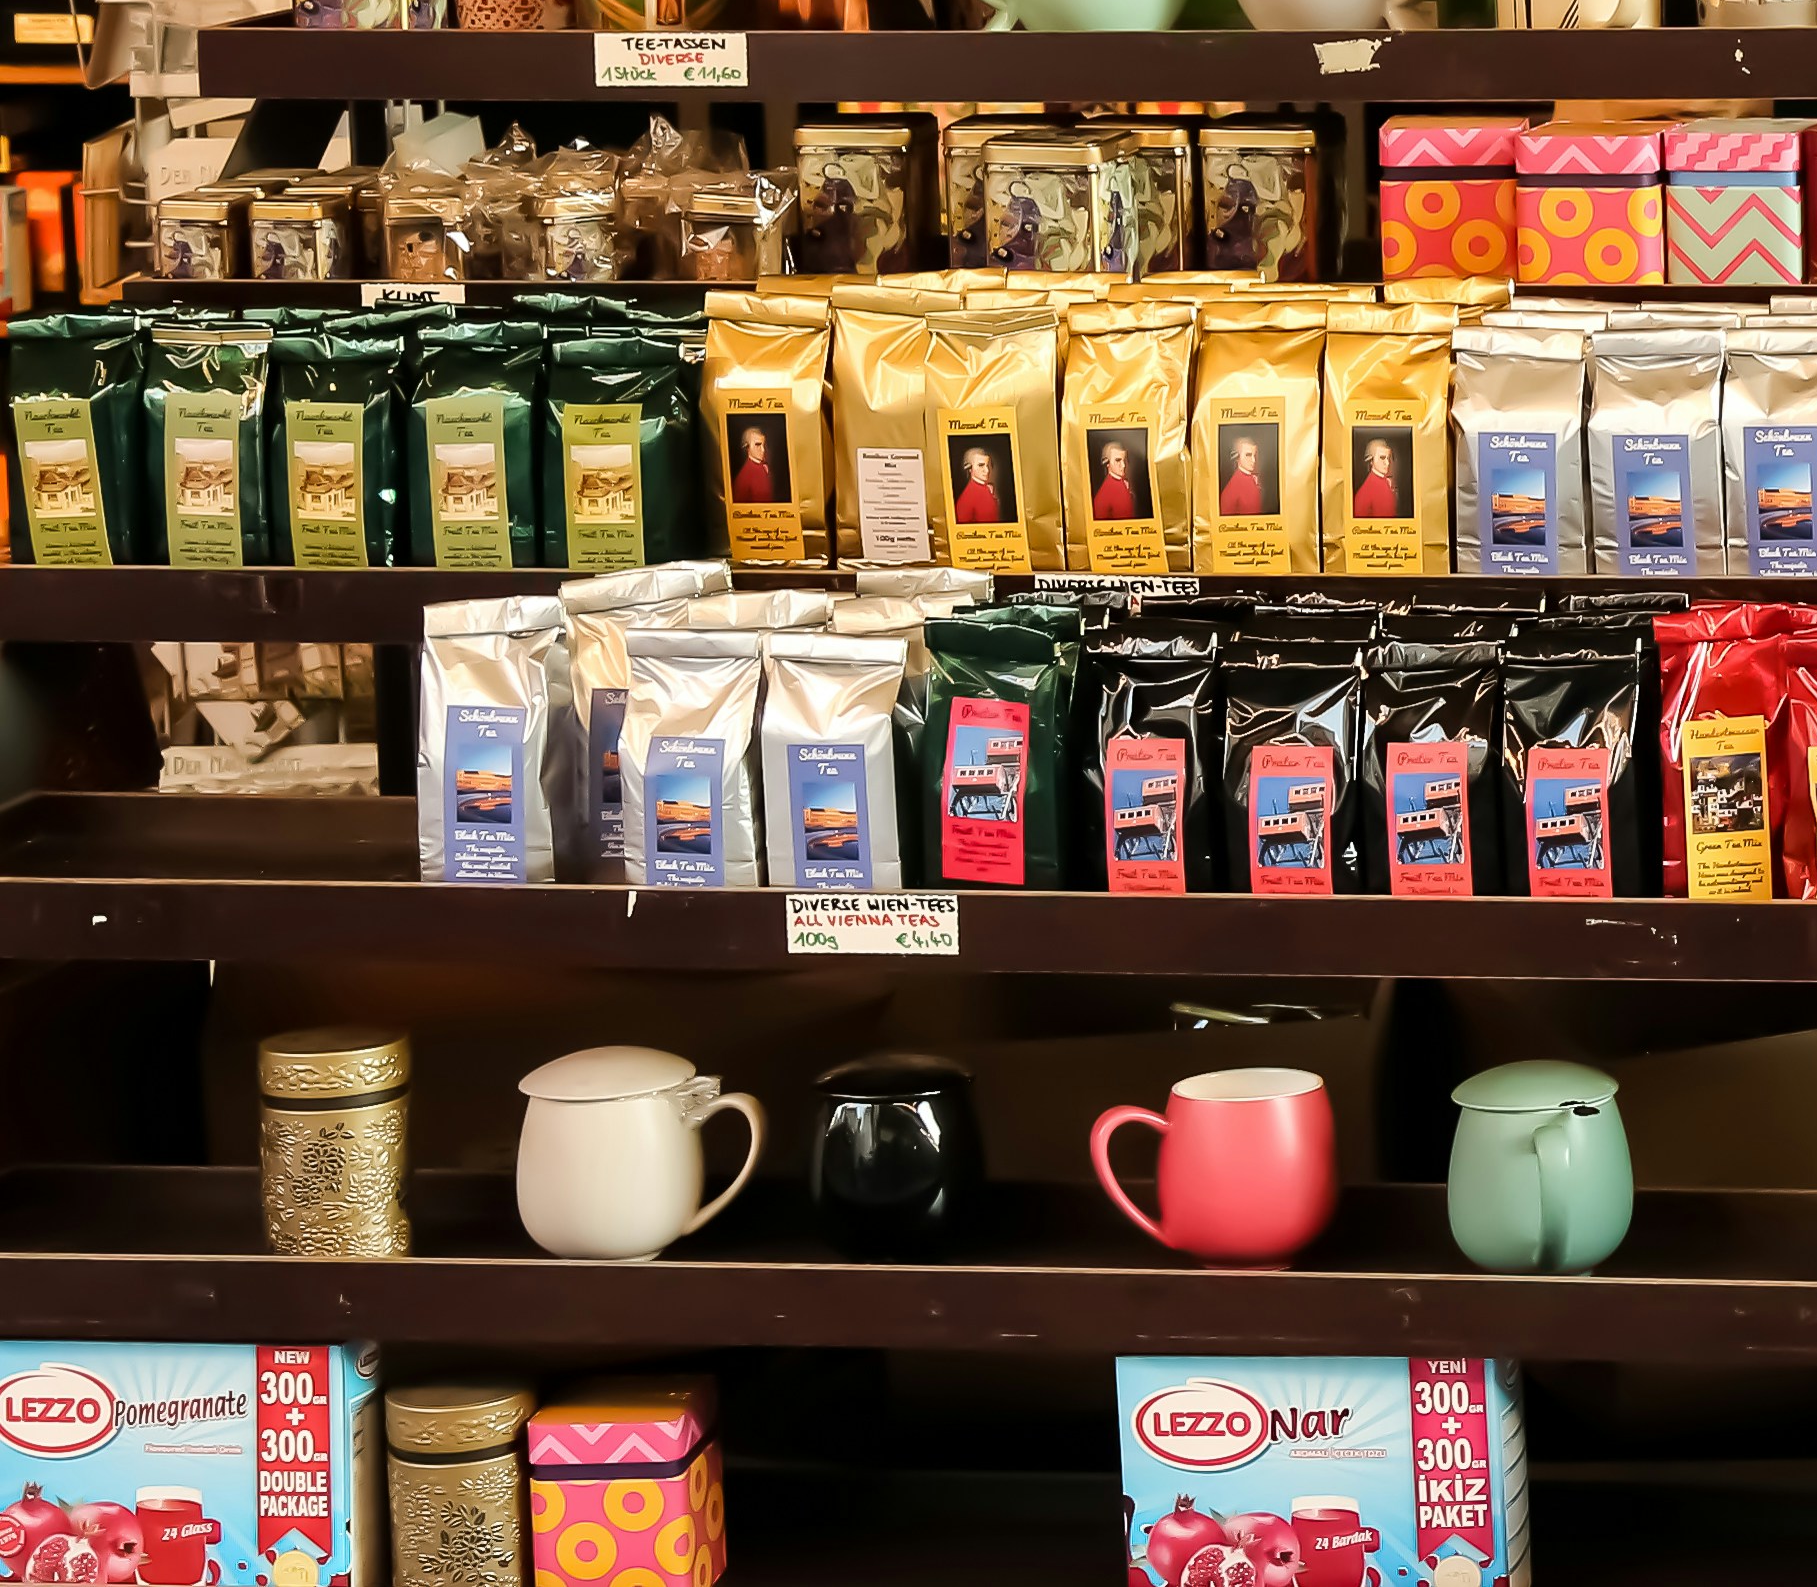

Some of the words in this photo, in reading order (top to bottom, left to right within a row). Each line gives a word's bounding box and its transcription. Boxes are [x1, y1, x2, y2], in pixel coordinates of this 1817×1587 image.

[621, 37, 727, 51] TEE-TASSEN
[638, 52, 705, 66] DIVERSE
[789, 897, 861, 913] DIVERSE
[866, 898, 956, 913] WIEN-TEES
[827, 913, 894, 927] VIENNA
[897, 914, 941, 927] TEAS
[793, 931, 839, 951] 100g
[273, 1350, 311, 1365] NEW
[1428, 1357, 1467, 1375] YENİ
[5, 1396, 101, 1424] LEZZO
[114, 1389, 248, 1429] Pomegranate
[1152, 1410, 1253, 1438] LEZZO
[1268, 1406, 1352, 1444] Nar
[259, 1469, 328, 1493] DOUBLE
[1418, 1473, 1488, 1503] İKİZ
[259, 1495, 329, 1518] PACKAGE
[1418, 1503, 1489, 1529] PAKET
[161, 1526, 178, 1541] 24
[180, 1521, 214, 1538] Glass
[1313, 1534, 1329, 1551] 24
[1331, 1527, 1373, 1549] Bardak
